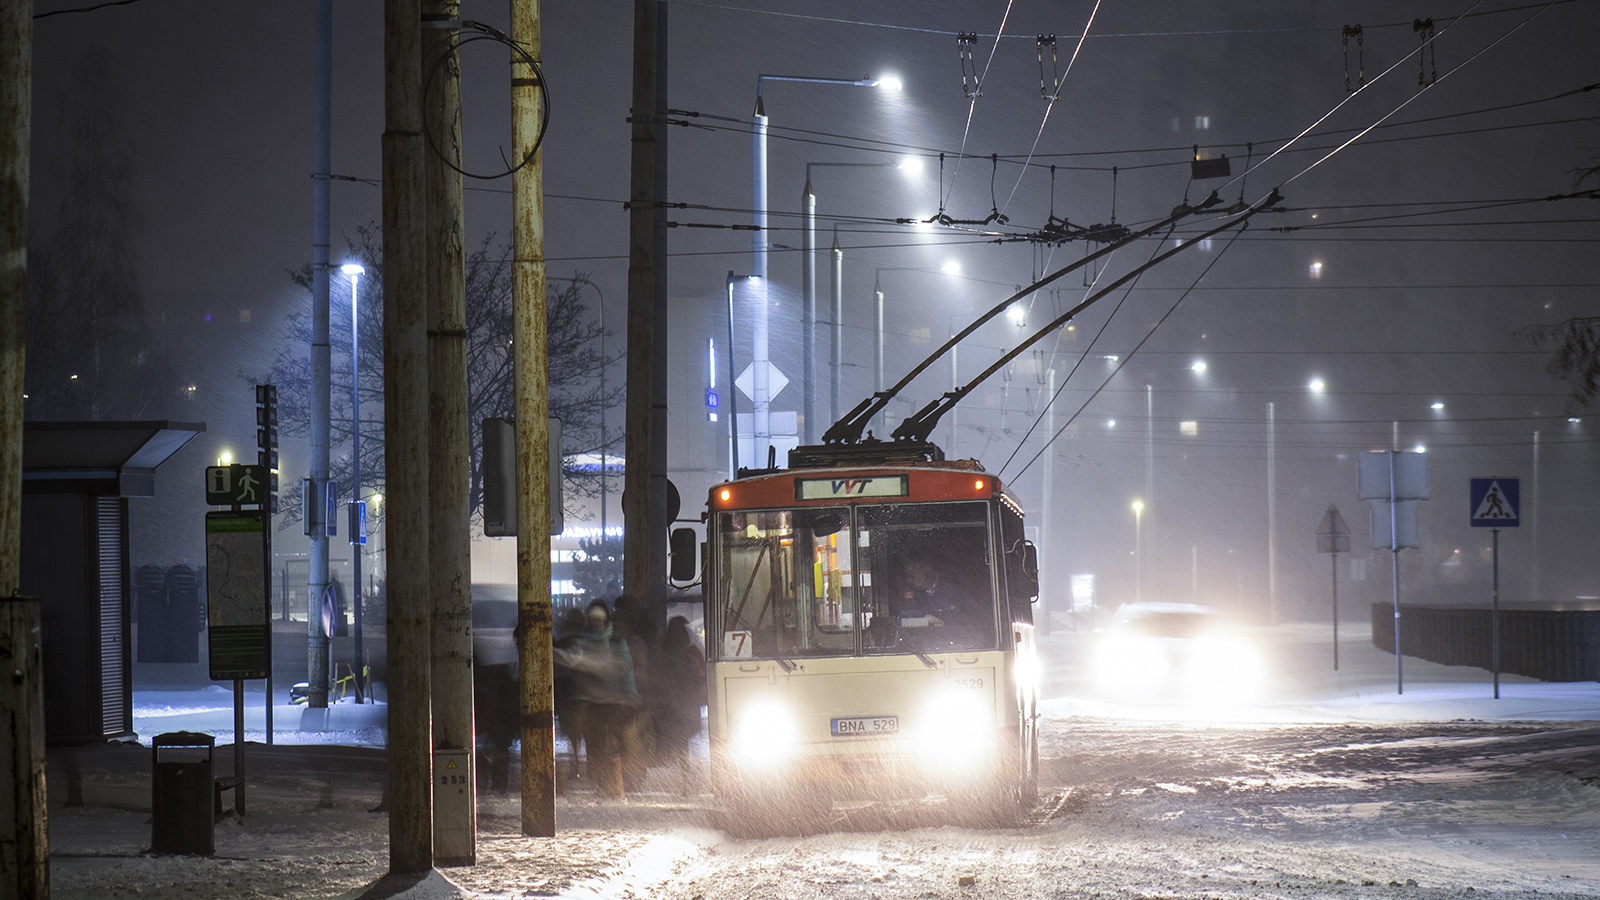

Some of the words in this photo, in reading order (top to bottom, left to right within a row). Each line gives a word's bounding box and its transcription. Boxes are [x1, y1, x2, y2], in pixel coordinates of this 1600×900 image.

[831, 479, 873, 495] VVT
[731, 633, 747, 657] 7
[953, 678, 984, 690] 2529
[839, 720, 866, 732] BNA
[873, 719, 896, 731] 529
[441, 775, 466, 785] 253
